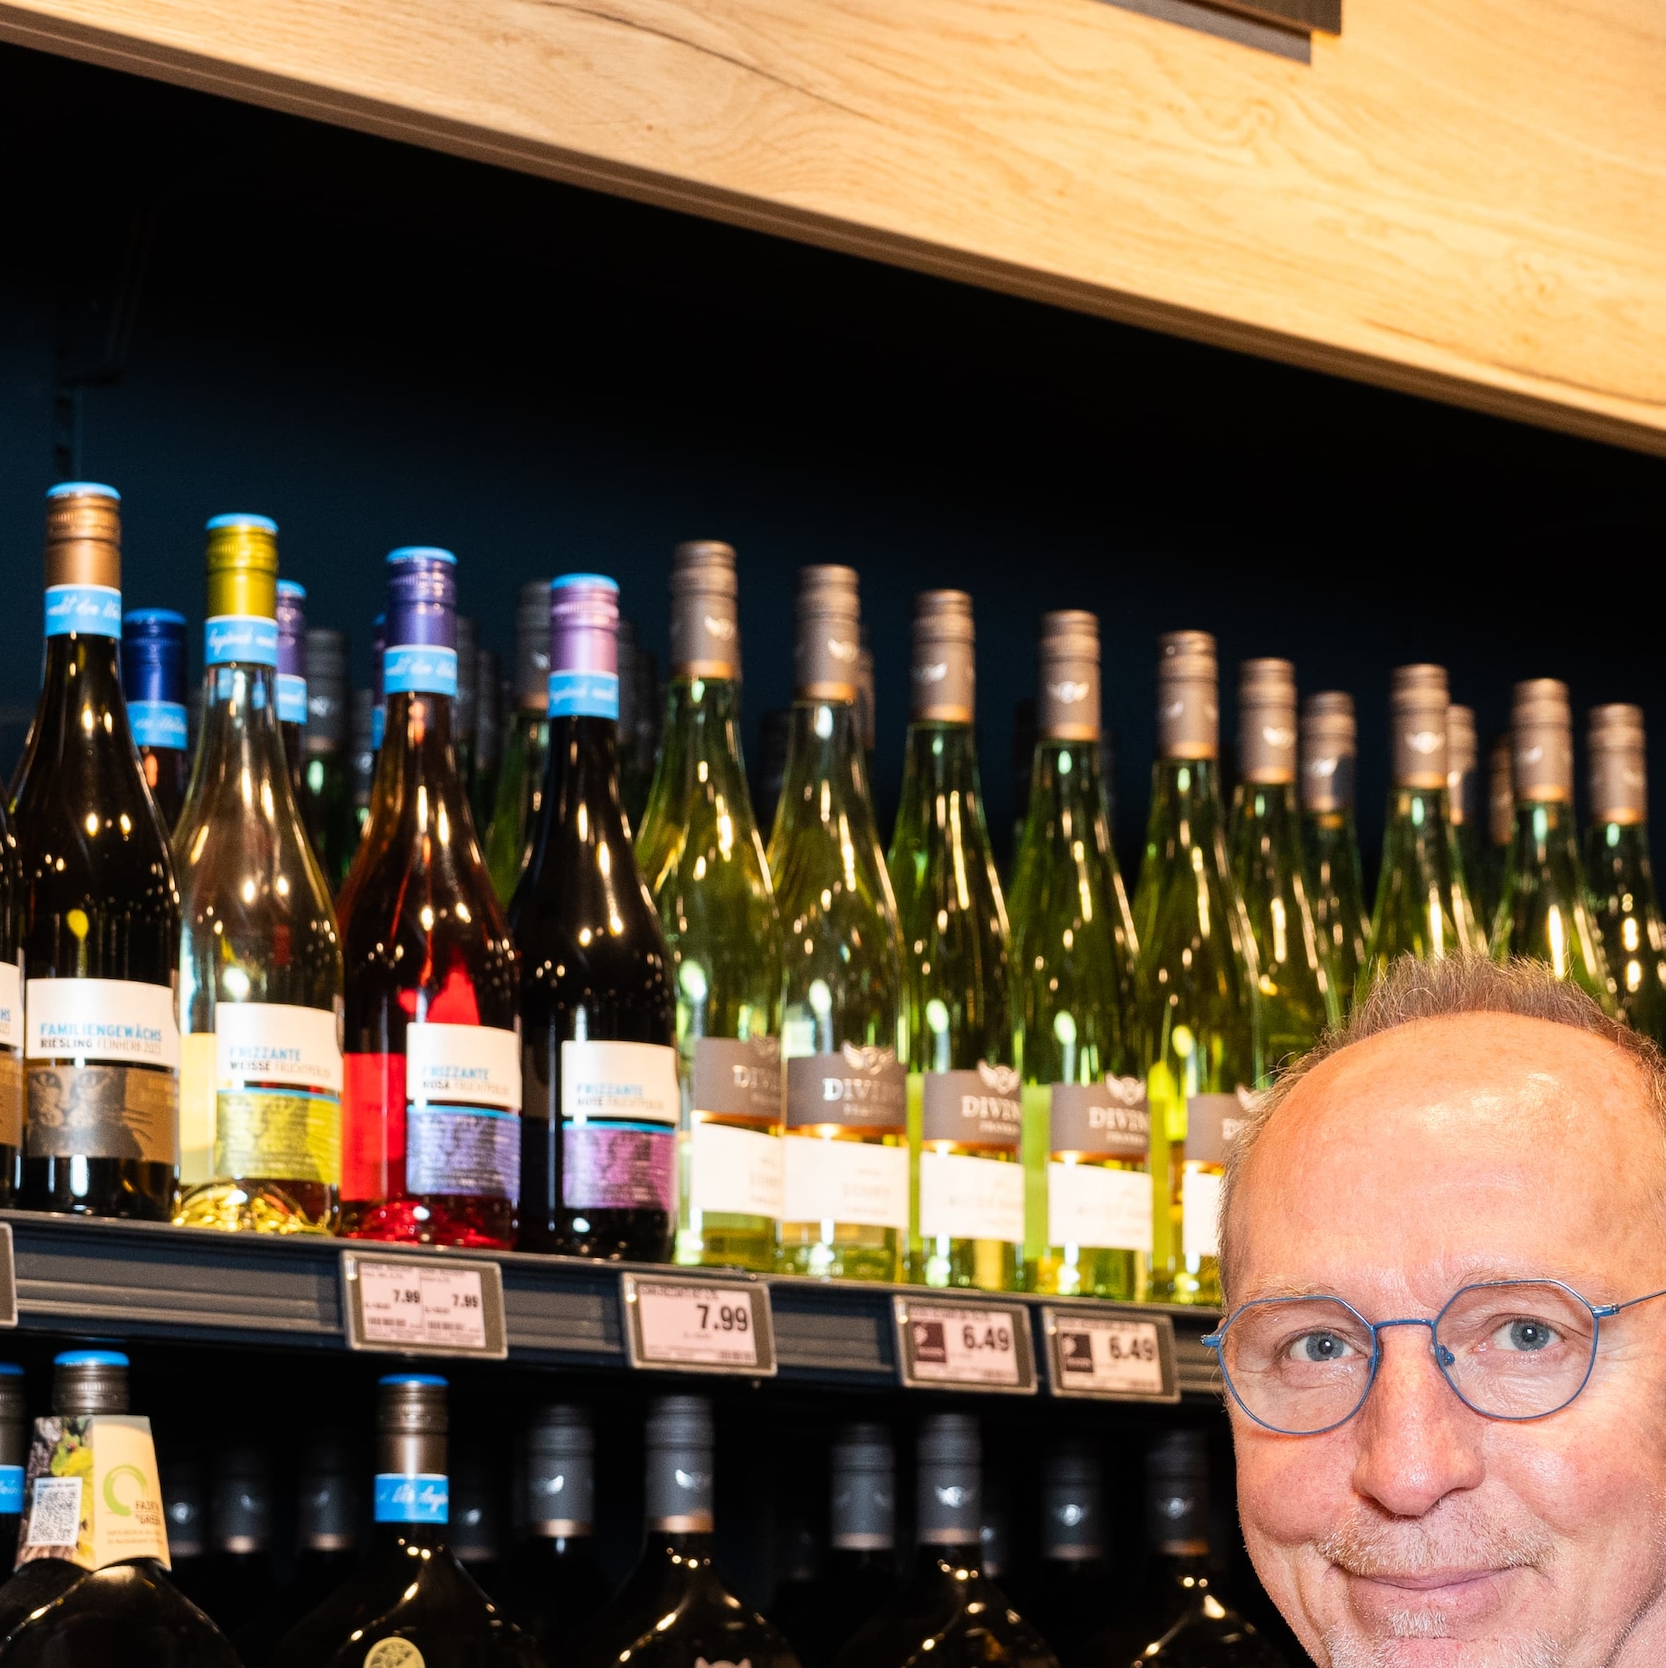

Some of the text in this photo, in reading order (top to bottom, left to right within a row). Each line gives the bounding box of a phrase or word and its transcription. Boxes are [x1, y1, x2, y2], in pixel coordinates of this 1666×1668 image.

[41, 1023, 161, 1041] FAMILIENGEWÄCHS
[41, 1039, 92, 1049] RIESLING
[697, 1304, 748, 1332] 7.99
[963, 1325, 1010, 1352] 6.49
[1109, 1336, 1153, 1361] 6.49
